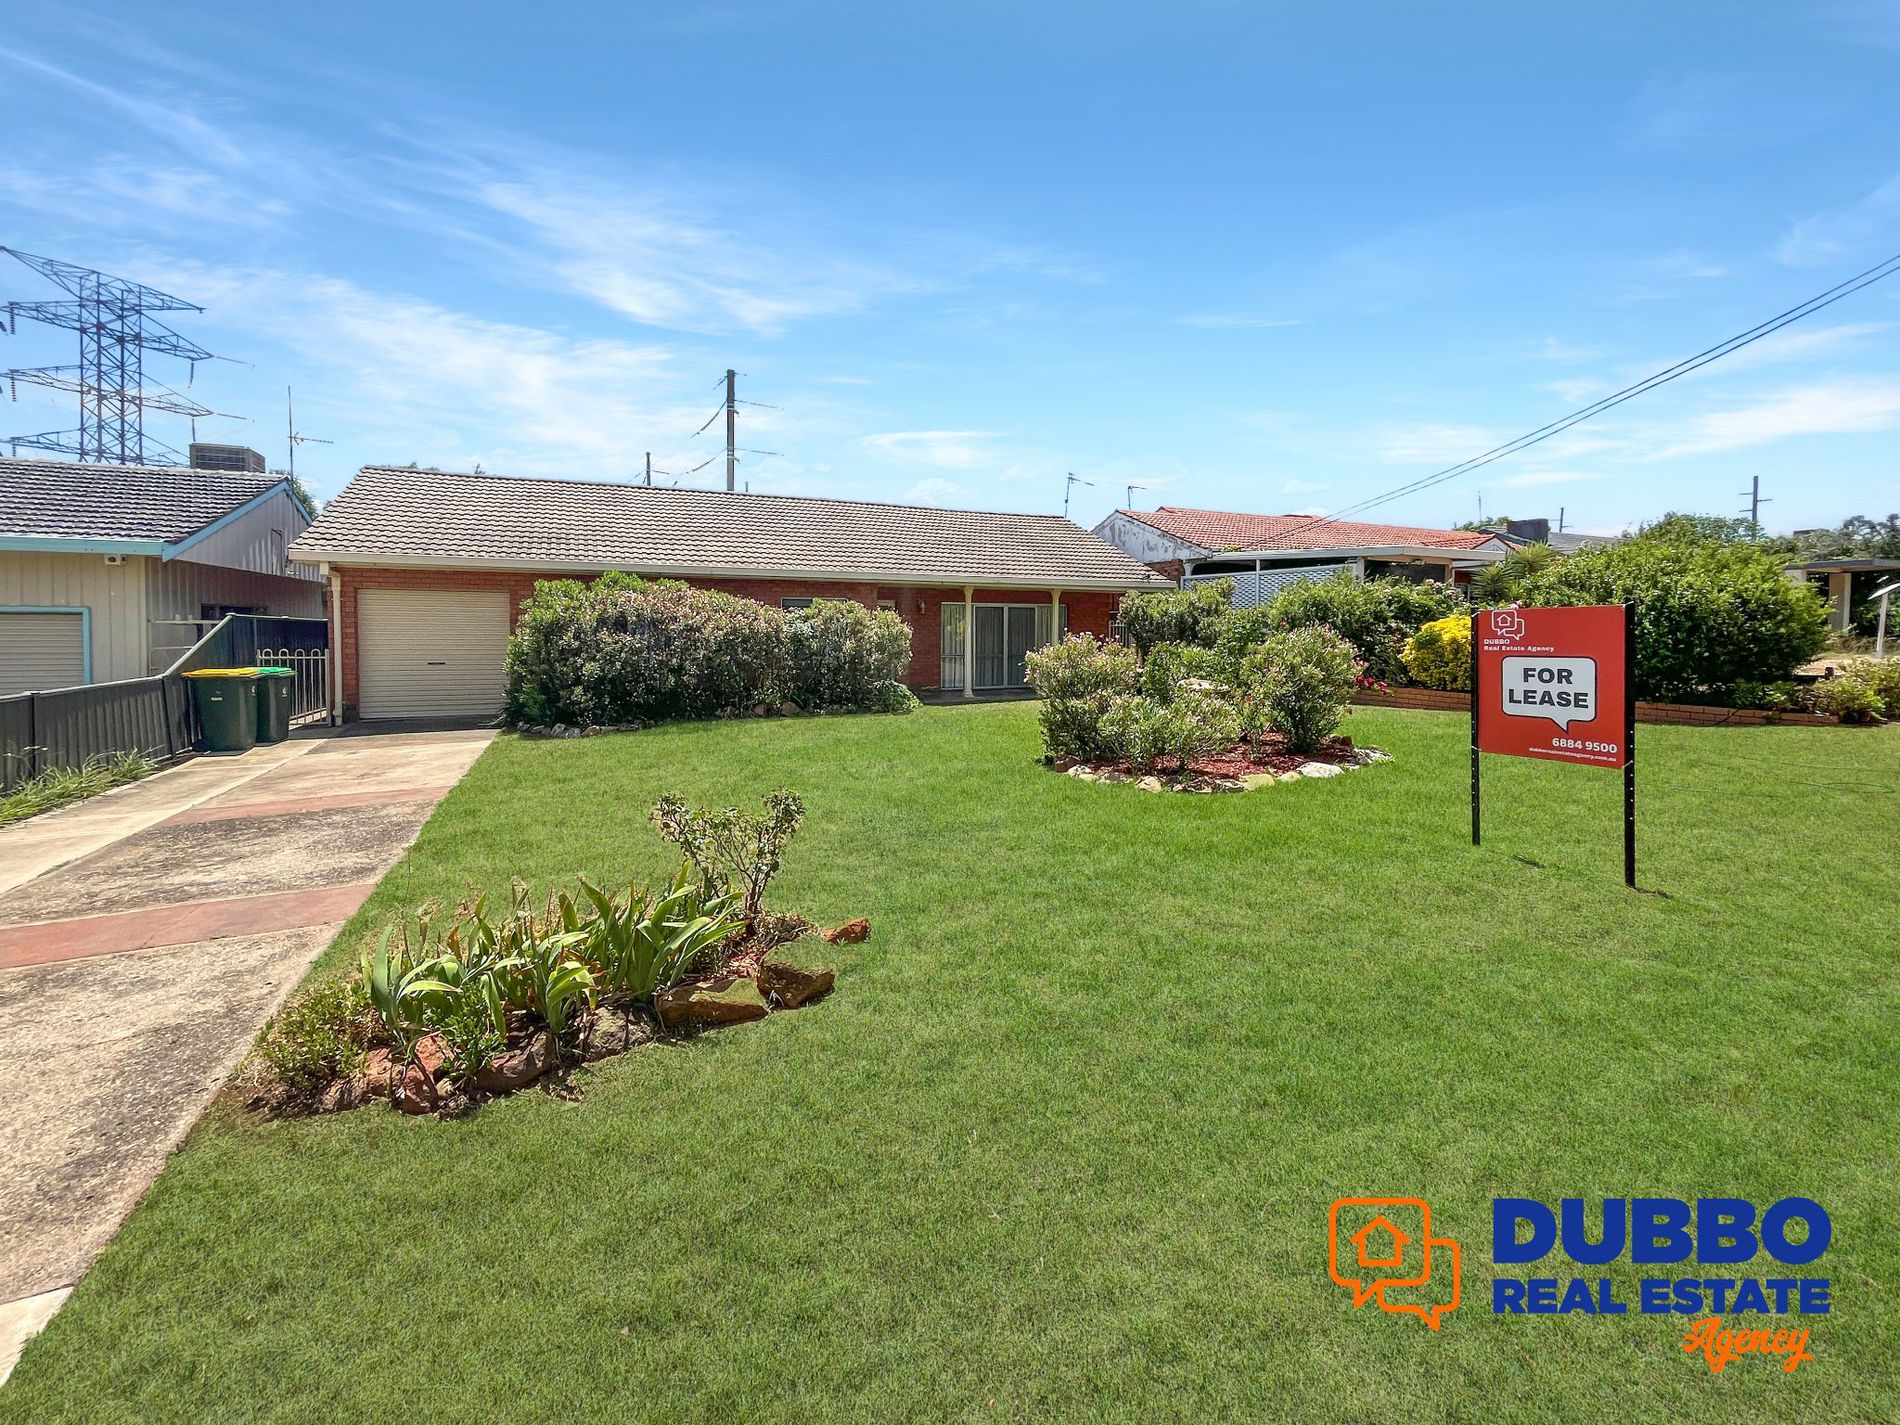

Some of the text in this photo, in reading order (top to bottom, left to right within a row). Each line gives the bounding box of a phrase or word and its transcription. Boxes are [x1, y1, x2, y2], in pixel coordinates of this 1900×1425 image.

[1523, 667, 1573, 684] FOR
[1508, 689, 1589, 709] LEASE
[1552, 738, 1618, 753] 6884 9500
